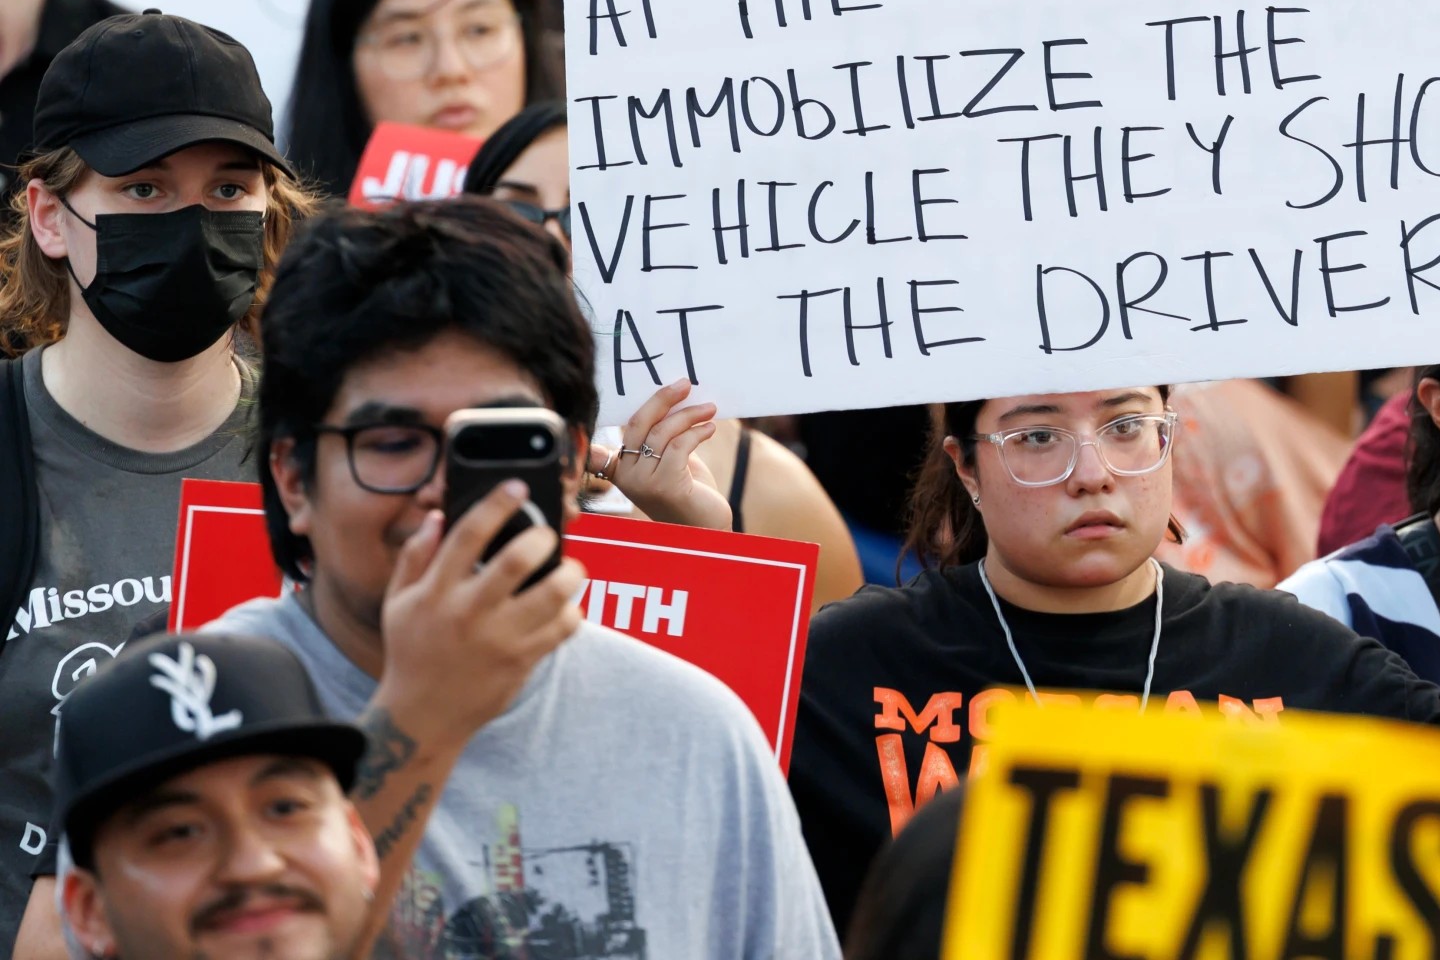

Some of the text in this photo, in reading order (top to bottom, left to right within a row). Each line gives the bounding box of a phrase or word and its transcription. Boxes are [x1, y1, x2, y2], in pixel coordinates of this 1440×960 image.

[1145, 6, 1322, 101] THE
[578, 168, 969, 284] VEHICLE
[997, 115, 1234, 222] THEY
[613, 305, 725, 395] AT
[777, 277, 986, 378] THE
